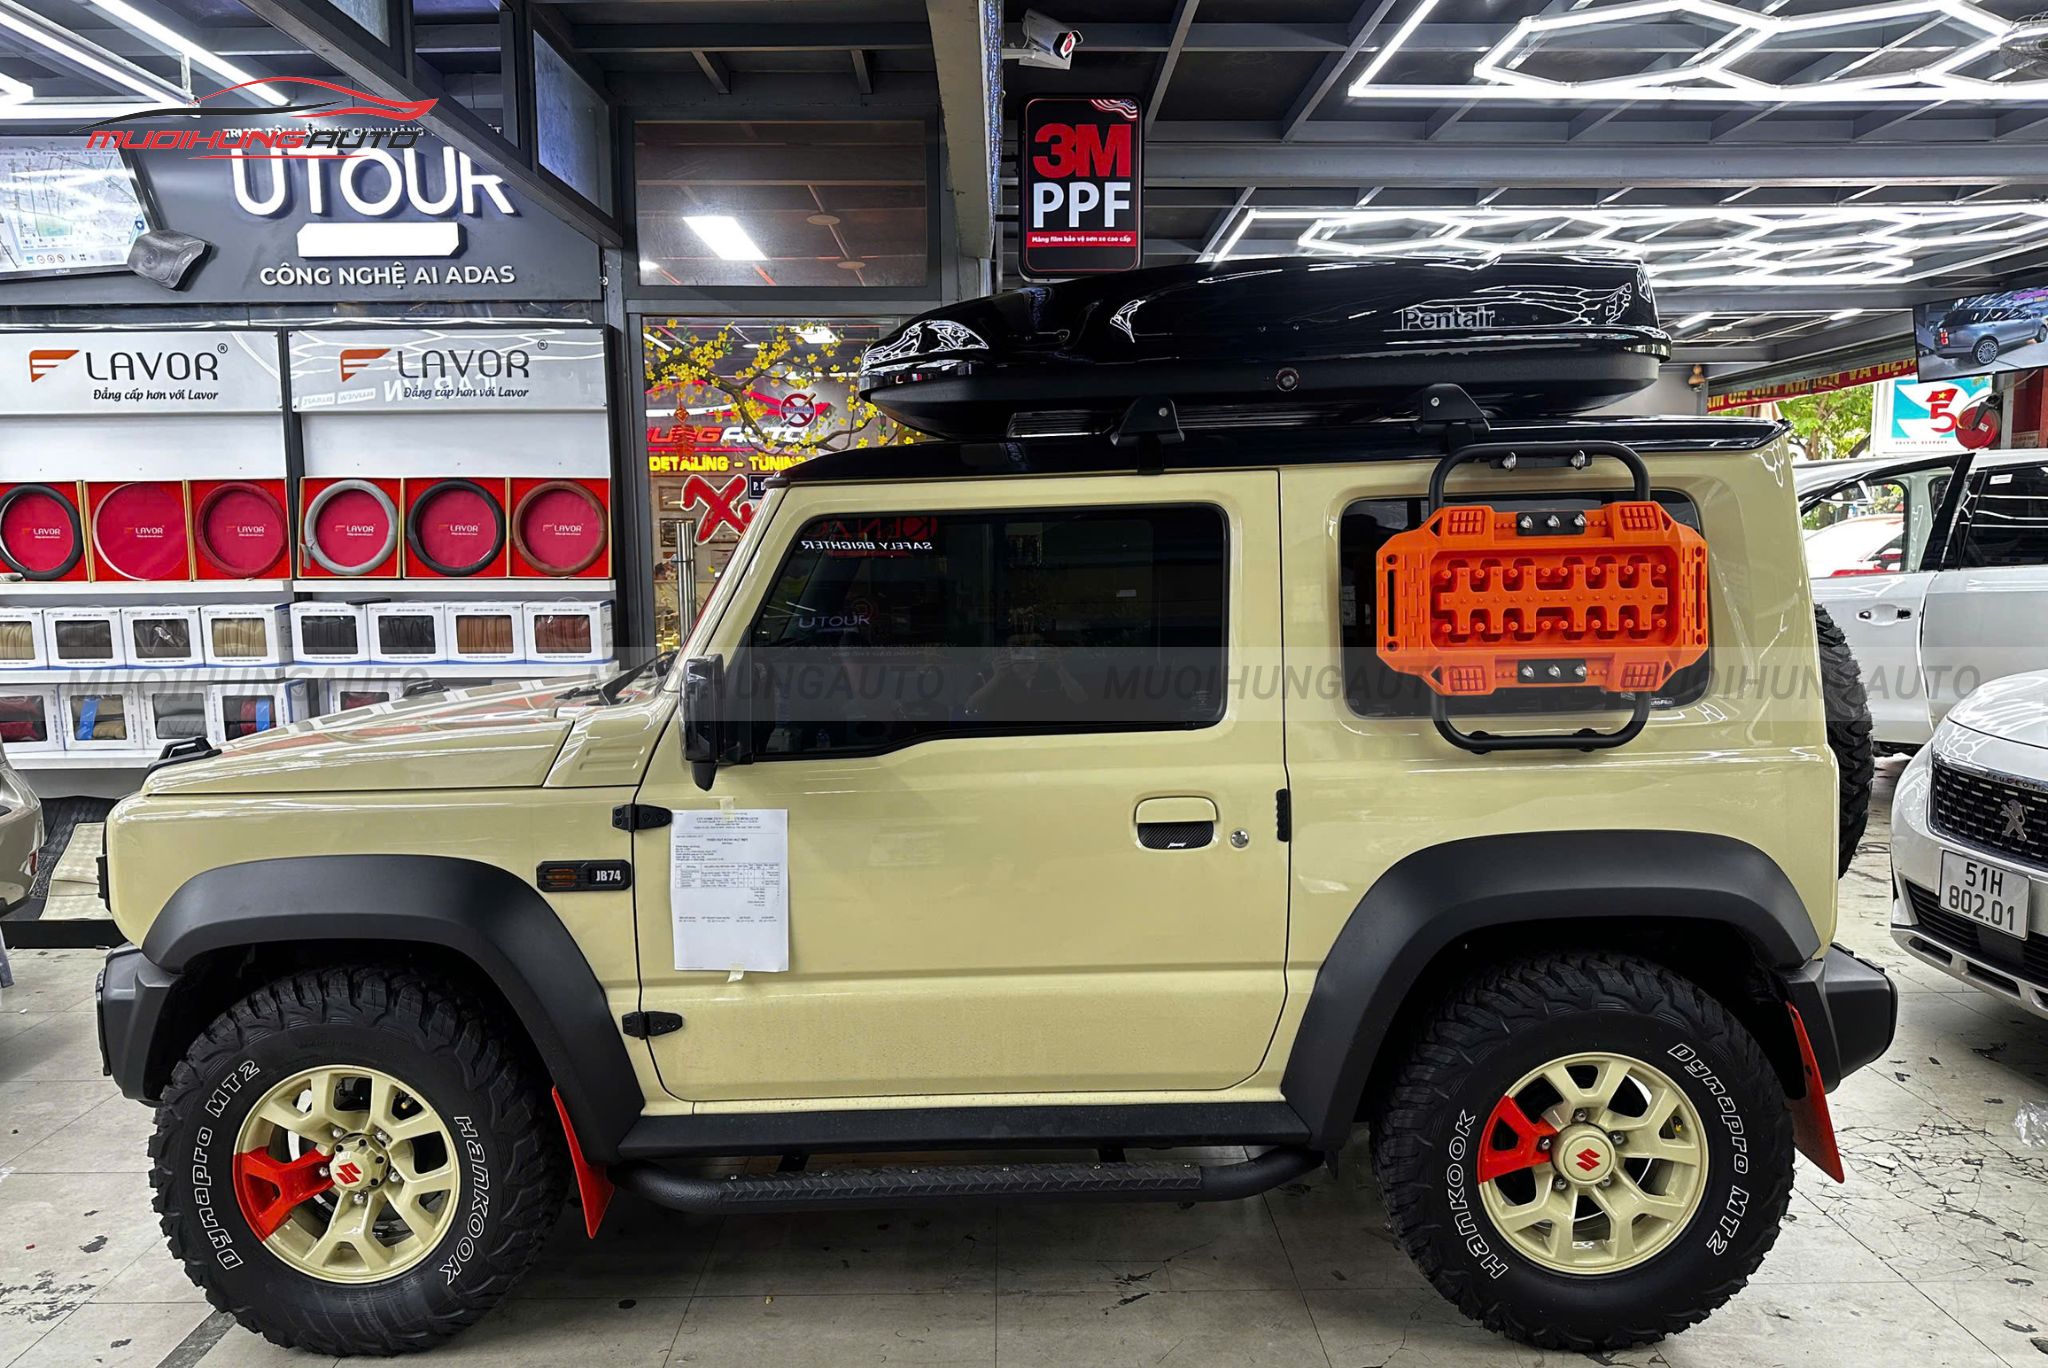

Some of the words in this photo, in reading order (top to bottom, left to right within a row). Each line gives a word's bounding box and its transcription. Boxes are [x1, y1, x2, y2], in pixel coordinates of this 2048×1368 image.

[1033, 123, 1132, 179] 3M
[231, 148, 514, 216] UTOUR
[1033, 182, 1131, 228] PPF
[260, 263, 331, 285] CÔNG
[338, 262, 407, 289] NGHỆ
[413, 267, 439, 284] AI
[446, 266, 516, 284] ADAS
[1402, 306, 1495, 330] Pentair
[86, 352, 218, 381] LAVOR
[397, 349, 530, 379] LAVOR
[93, 387, 121, 401] Đẳng
[125, 387, 143, 401] cấp
[146, 388, 167, 400] hơn
[169, 388, 186, 400] với
[188, 388, 219, 401] Lavor
[435, 384, 454, 399] cấp
[456, 386, 477, 398] hơn
[479, 386, 496, 398] với
[498, 386, 530, 398] Lavor
[649, 455, 729, 472] DETAILING
[749, 455, 807, 472] TUNIN
[596, 870, 621, 881] JB74
[1965, 861, 2004, 897] 51H
[1949, 885, 2015, 931] 802.01
[205, 1060, 260, 1118] MT2
[1667, 1043, 1748, 1174] Dynapro
[192, 1127, 243, 1270] Dynapro
[1706, 1185, 1750, 1255] MT2
